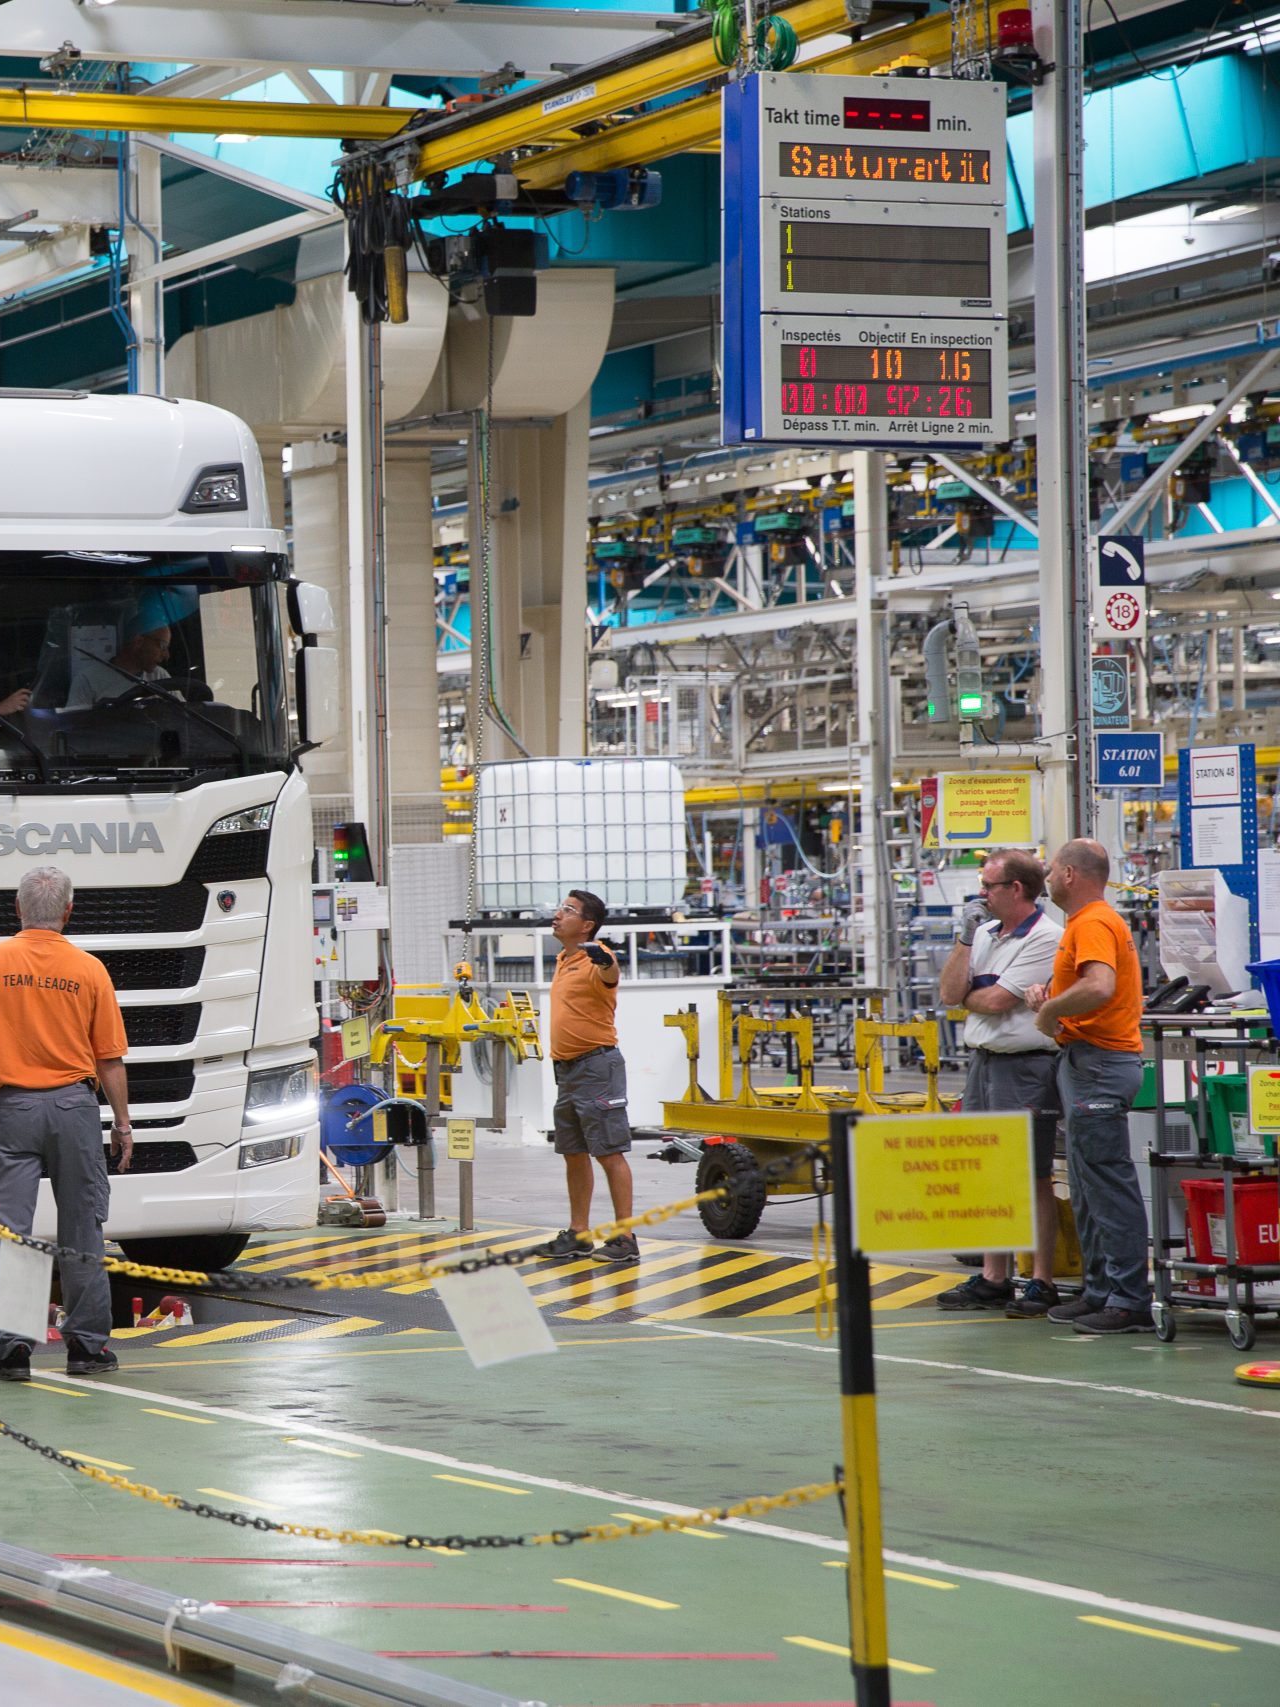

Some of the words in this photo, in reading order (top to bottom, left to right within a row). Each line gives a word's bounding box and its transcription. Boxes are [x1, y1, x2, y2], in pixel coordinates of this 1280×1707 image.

[764, 107, 799, 124] Takt
[804, 109, 840, 126] time
[937, 115, 972, 132] min.
[780, 205, 831, 219] Stations
[782, 329, 841, 343] Inspectés
[858, 331, 906, 345] Objectif
[911, 332, 927, 343] En
[930, 333, 993, 346] inspection
[783, 418, 828, 434] Dépass
[832, 420, 850, 431] T.T.
[854, 421, 880, 432] min.
[888, 420, 918, 432] Arrêt
[922, 421, 954, 436] Ligne
[957, 422, 965, 433] 2
[970, 423, 993, 434] min.
[1114, 605, 1131, 619] 18
[1102, 749, 1157, 761] STATION
[1118, 766, 1141, 777] 6.01
[1195, 768, 1225, 779] STATION
[1226, 767, 1235, 777] 48
[948, 777, 967, 785] Zone
[1013, 776, 1026, 784] des
[956, 788, 984, 796] chariots
[960, 799, 988, 807] passage
[989, 798, 1016, 806] interdit
[948, 810, 986, 818] emprunter
[3, 974, 34, 987] TEAM
[38, 976, 80, 996] LEADER
[883, 1138, 901, 1150] NE
[905, 1136, 936, 1149] RIEN
[939, 1133, 999, 1148] DEPOSER
[903, 1160, 940, 1173] DANS
[943, 1158, 982, 1171] CETTE
[925, 1183, 960, 1196] ZONE
[932, 1207, 944, 1219] ni
[948, 1204, 1015, 1220] matériels)
